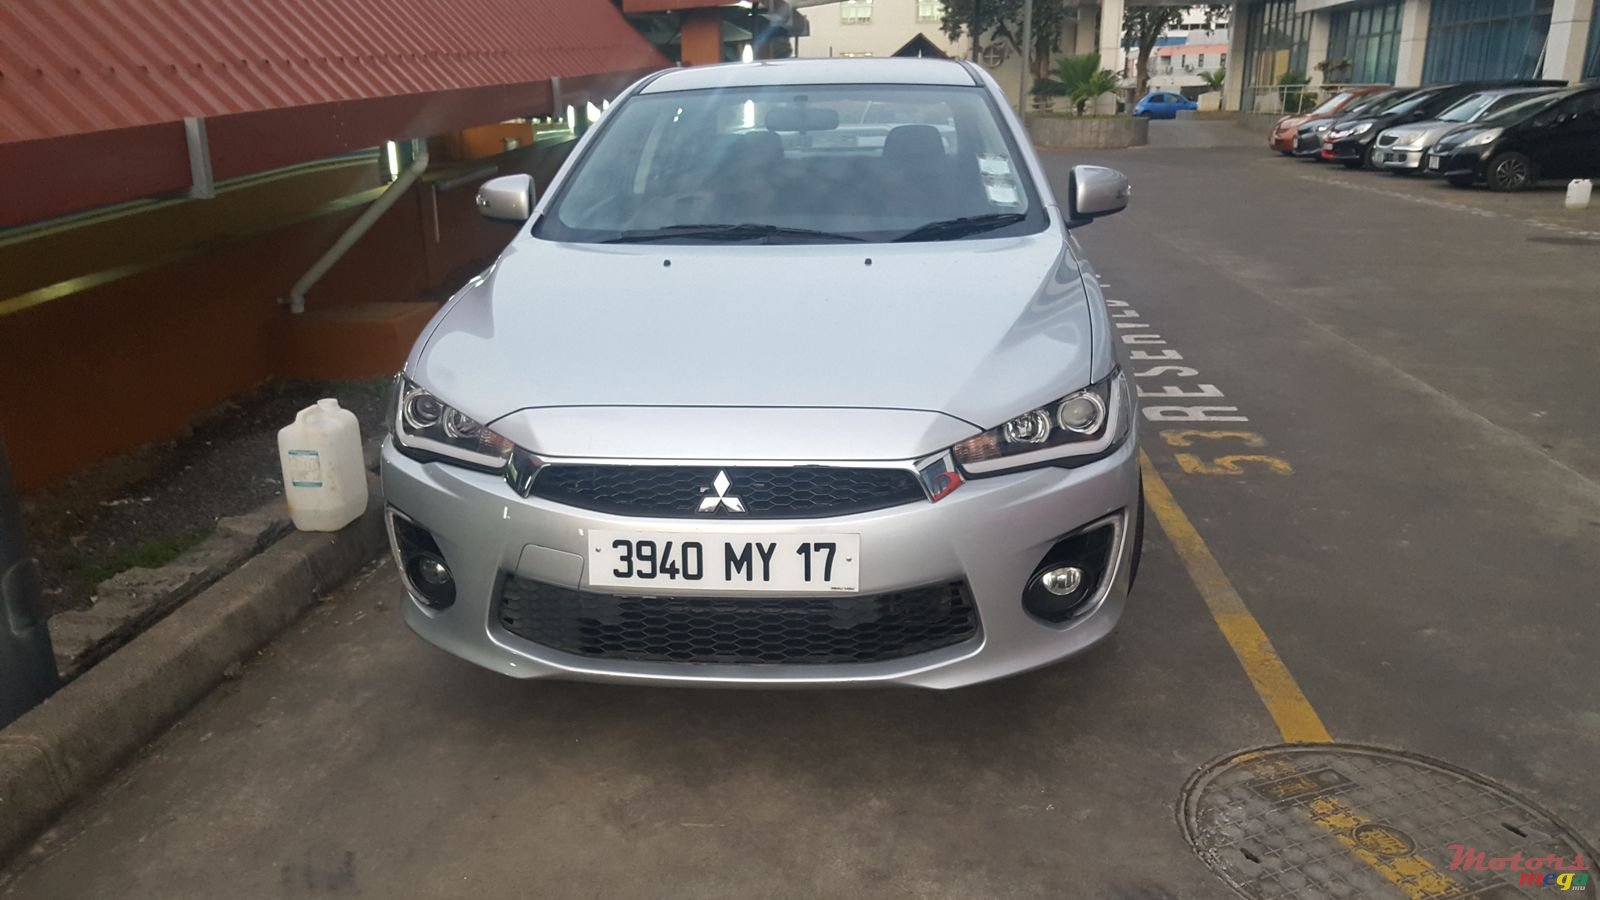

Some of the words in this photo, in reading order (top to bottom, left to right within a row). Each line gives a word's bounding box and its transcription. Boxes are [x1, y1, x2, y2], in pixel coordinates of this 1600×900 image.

[612, 539, 703, 580] 3940
[724, 542, 777, 582] MY
[796, 542, 837, 582] 17
